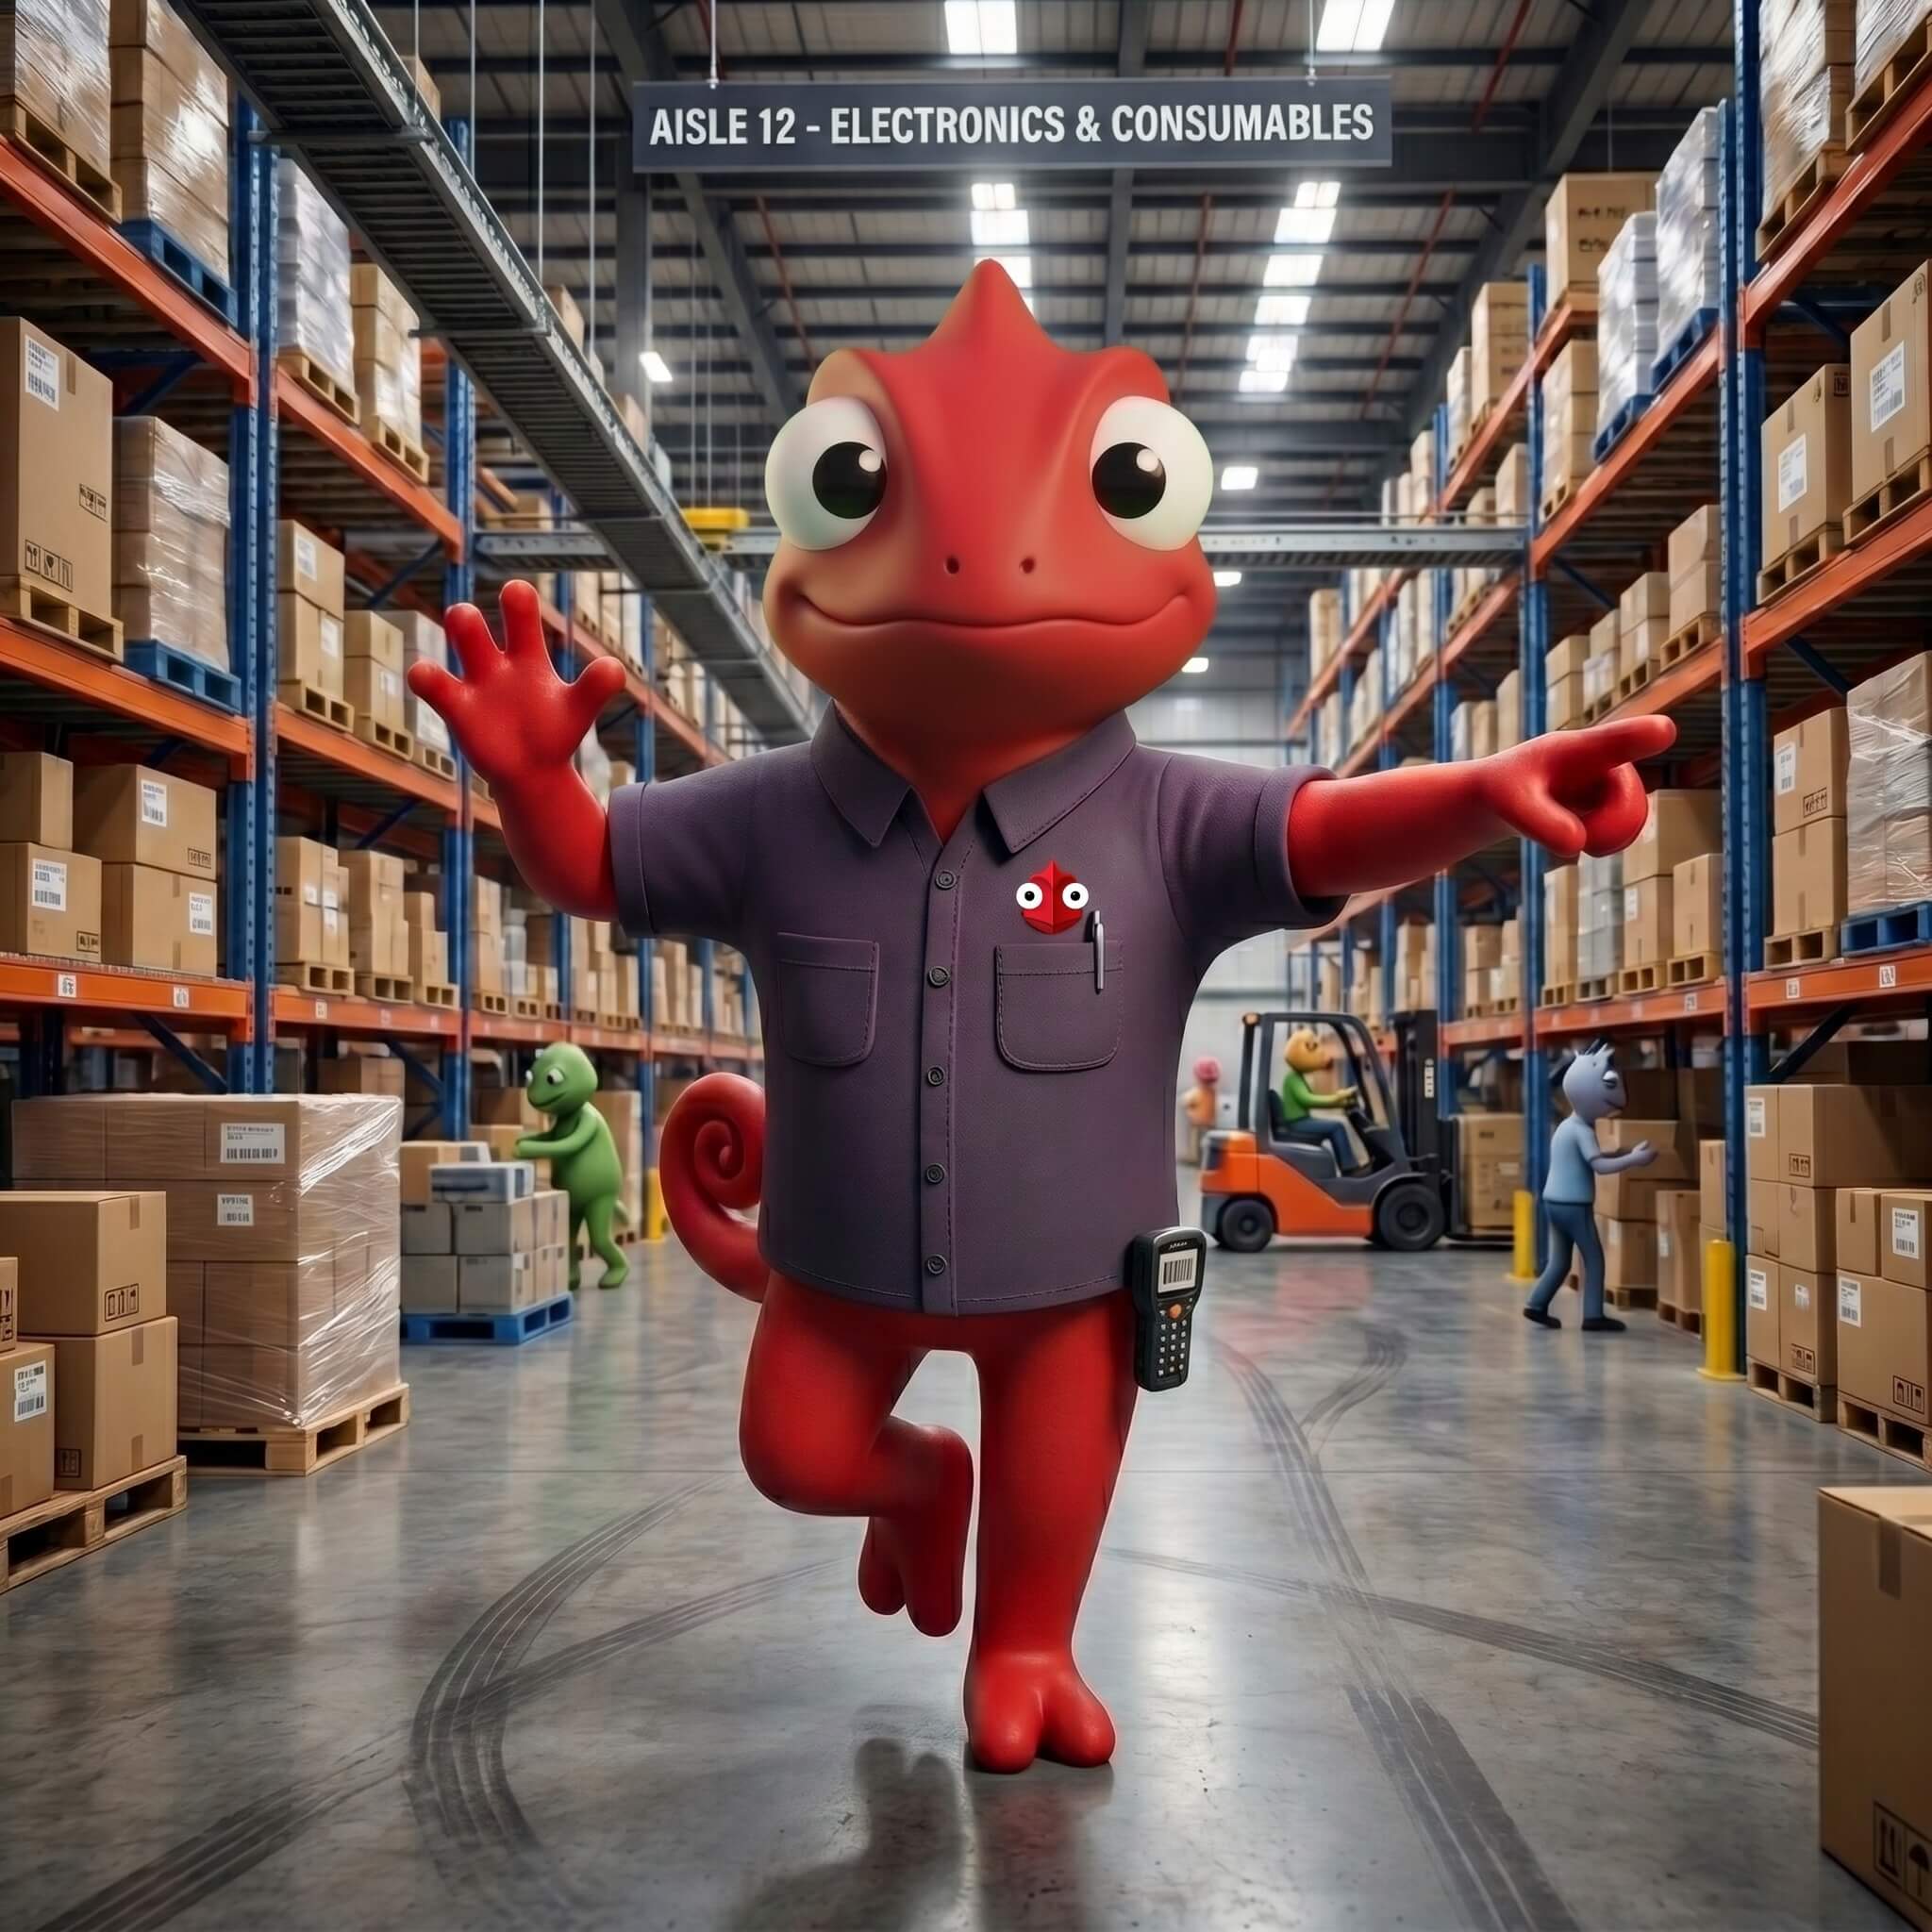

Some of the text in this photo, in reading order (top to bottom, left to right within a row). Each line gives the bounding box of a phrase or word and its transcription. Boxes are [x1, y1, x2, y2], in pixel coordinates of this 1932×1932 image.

[649, 108, 748, 145] AISLE
[758, 107, 796, 145] 12
[831, 105, 1066, 145] ELECTRONICS
[1074, 105, 1102, 143] &
[1111, 103, 1374, 143] CONSUMABLES
